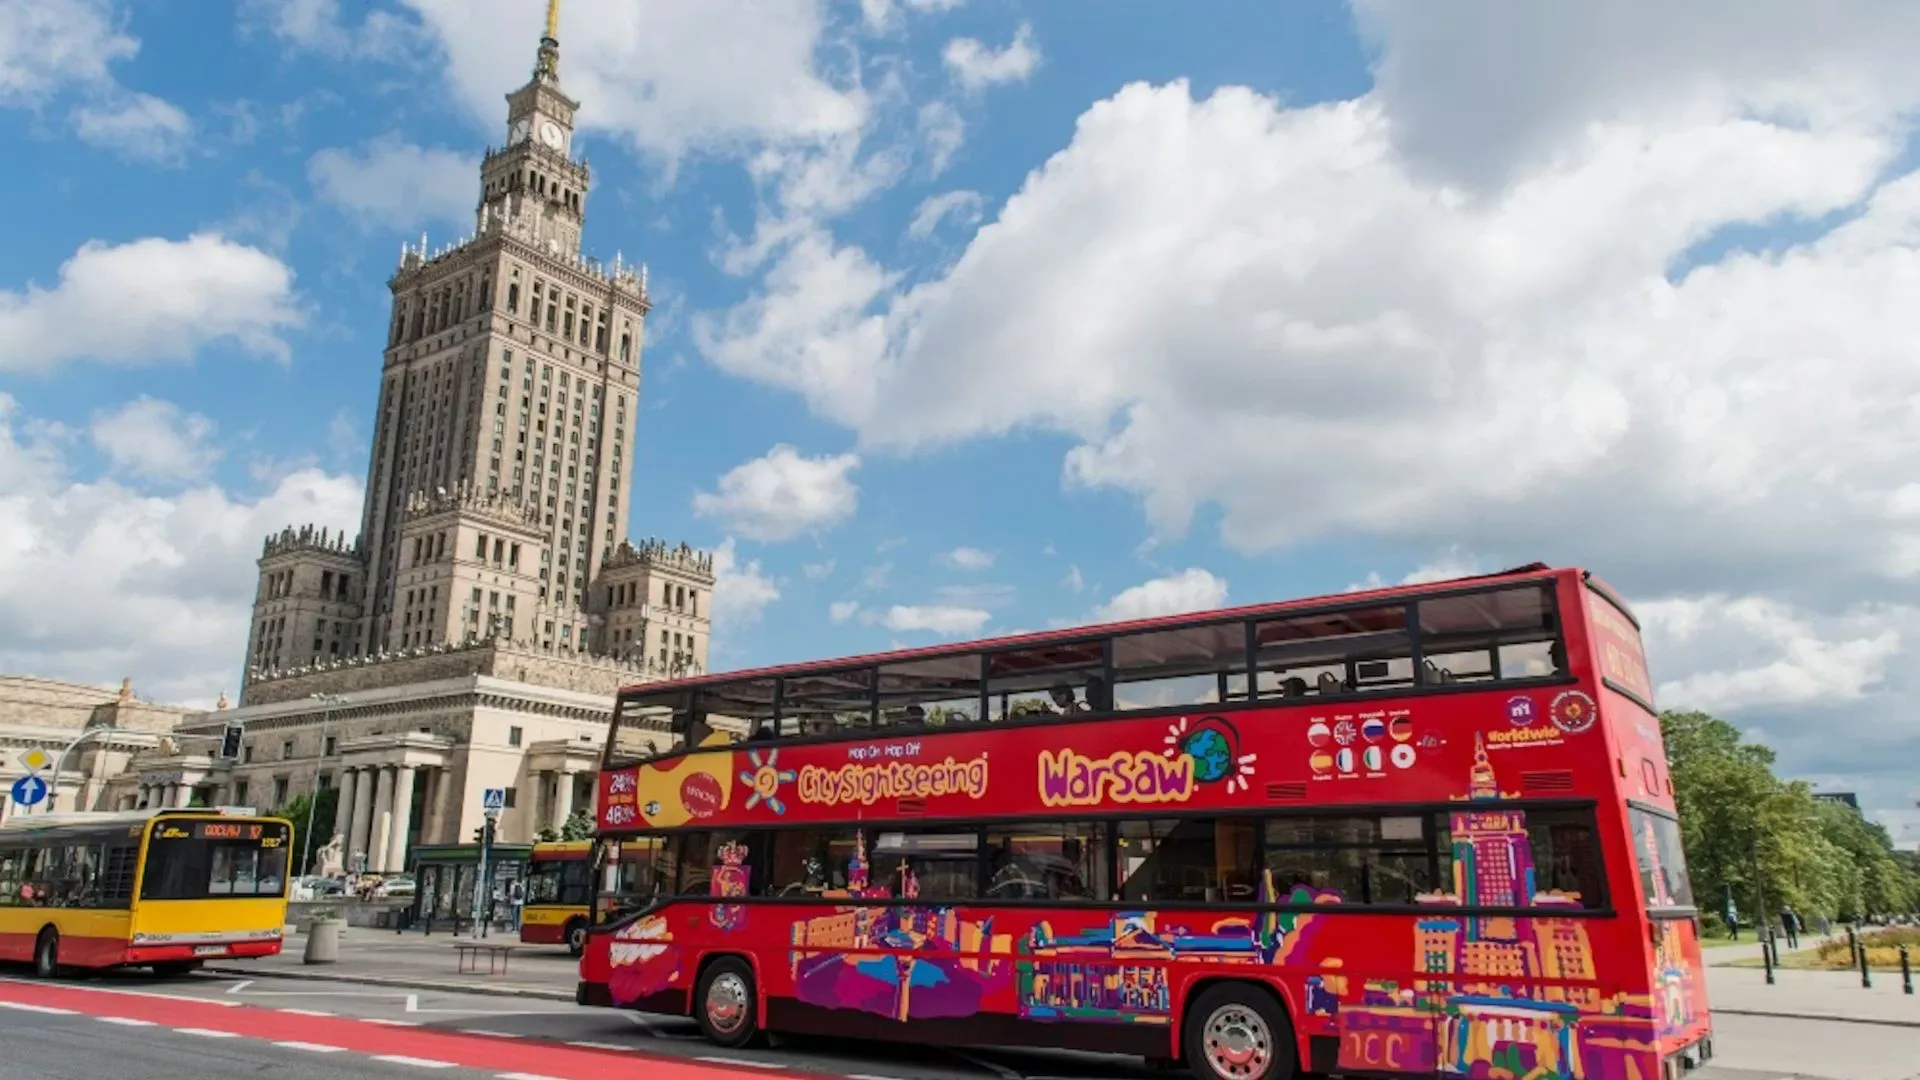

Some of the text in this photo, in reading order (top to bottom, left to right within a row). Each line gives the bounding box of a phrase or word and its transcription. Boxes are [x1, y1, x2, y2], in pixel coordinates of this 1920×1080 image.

[848, 747, 867, 760] Hop
[884, 745, 903, 757] Hop
[905, 742, 921, 755] Off
[798, 756, 988, 806] CitySightseeing
[1038, 748, 1195, 807] Warsaw
